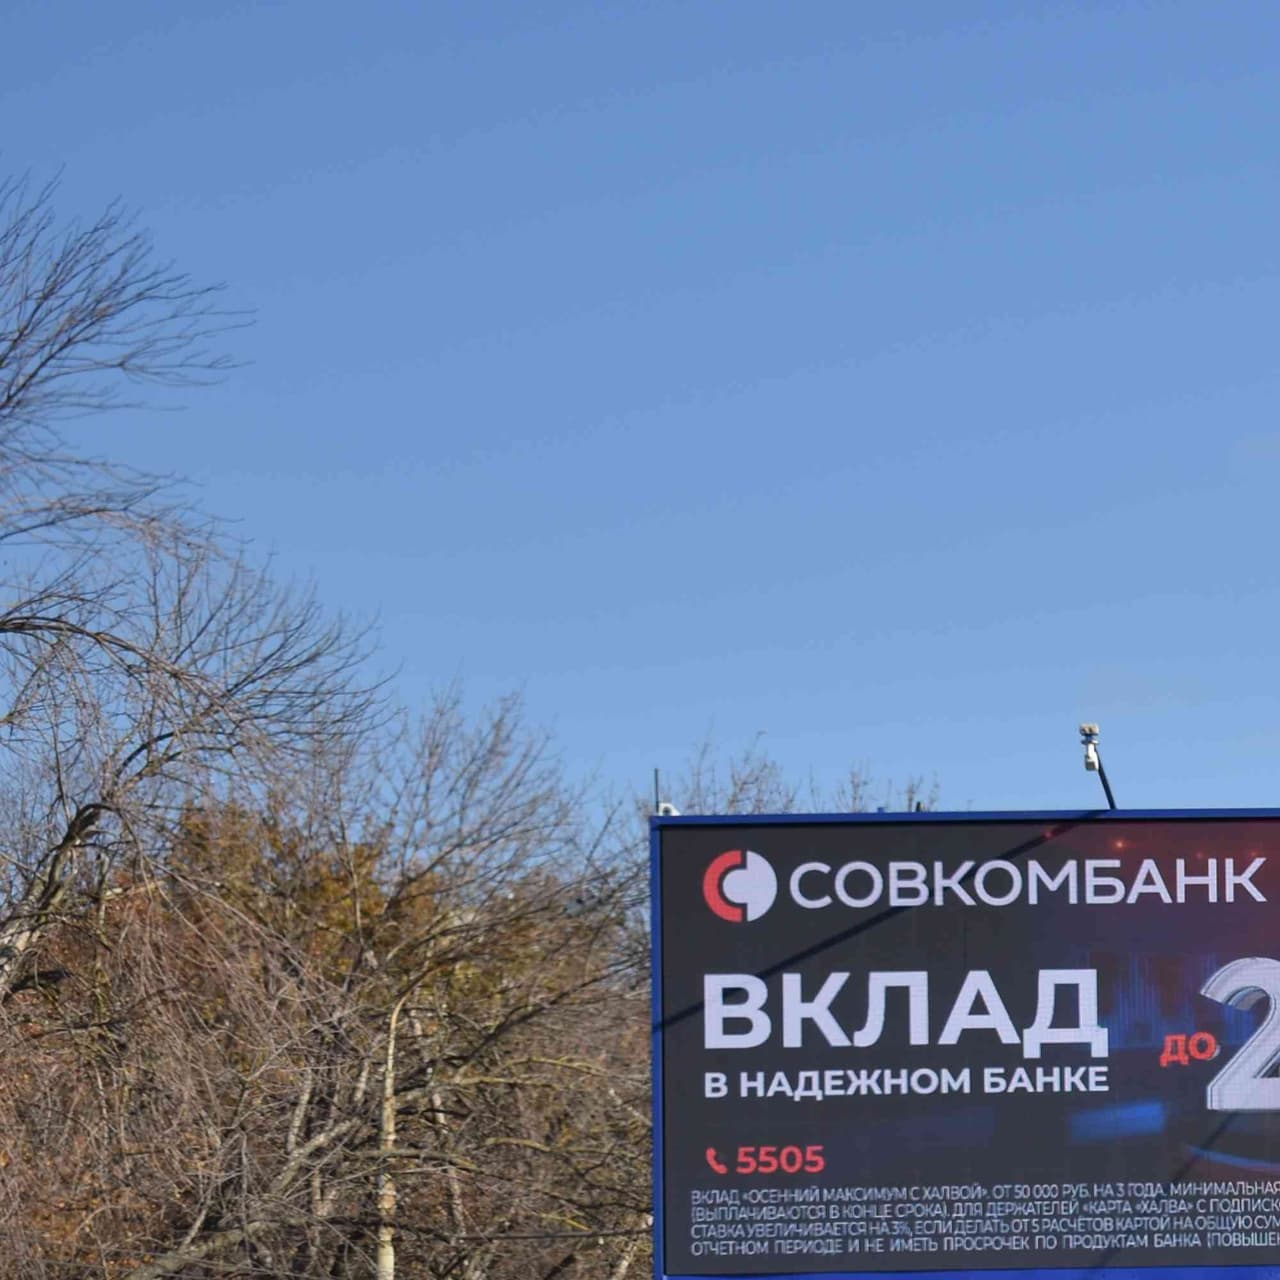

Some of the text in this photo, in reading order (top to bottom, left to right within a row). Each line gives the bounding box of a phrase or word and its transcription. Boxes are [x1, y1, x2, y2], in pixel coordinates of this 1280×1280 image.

[788, 856, 1267, 909] СОВКОМБАНК
[704, 968, 1109, 1062] ВКЛАД
[704, 1065, 1109, 1103] В НАДЕЖНОМ БАНКЕ
[736, 1145, 825, 1175] 5505
[691, 1190, 740, 1206] ВКЛАД
[743, 1186, 820, 1204] «ОСЕННИЙ
[823, 1187, 906, 1202] МАКСИМУМ
[910, 1187, 920, 1201] С
[993, 1185, 1012, 1199] ОТ
[1014, 1185, 1030, 1199] 50
[1033, 1185, 1058, 1198] 000
[1063, 1184, 1090, 1199] РУБ.
[1093, 1183, 1114, 1197] НА
[1116, 1183, 1125, 1197] 3
[691, 1205, 826, 1222] (ВЫПЛАЧИВАЮТСЯ
[829, 1206, 840, 1219] В
[843, 1205, 892, 1220] КОНЦЕ
[952, 1202, 983, 1218] ДЛЯ
[985, 1200, 1079, 1217] ДЕРЖАТЕЛЕЙ
[1082, 1200, 1132, 1214] «КАРТА
[1136, 1199, 1193, 1214] «ХАЛВА»
[1196, 1199, 1207, 1213] С
[690, 1224, 750, 1240] СТАВКА
[750, 1222, 867, 1238] УВЕЛИЧИВАЕТСЯ
[868, 1221, 889, 1236] НА
[915, 1220, 952, 1235] ЕСЛИ
[954, 1218, 1010, 1235] ДЕЛАТЬ
[1011, 1218, 1030, 1233] ОТ
[1032, 1218, 1040, 1232] 5
[1116, 1214, 1170, 1231] КАРТОЙ
[1173, 1216, 1193, 1230] НА
[1195, 1214, 1252, 1232] ОБЩУЮ
[690, 1241, 769, 1256] ОТЧЕТНОМ
[774, 1239, 843, 1256] ПЕРИОДЕ
[848, 1239, 860, 1253] И
[864, 1238, 884, 1253] НЕ
[890, 1237, 938, 1252] ИМЕТЬ
[943, 1235, 1030, 1252] ПРОСРОЧЕК
[1035, 1235, 1057, 1249] ПО
[1063, 1234, 1148, 1251] ПРОДУКТАМ
[1154, 1232, 1200, 1248] БАНКА
